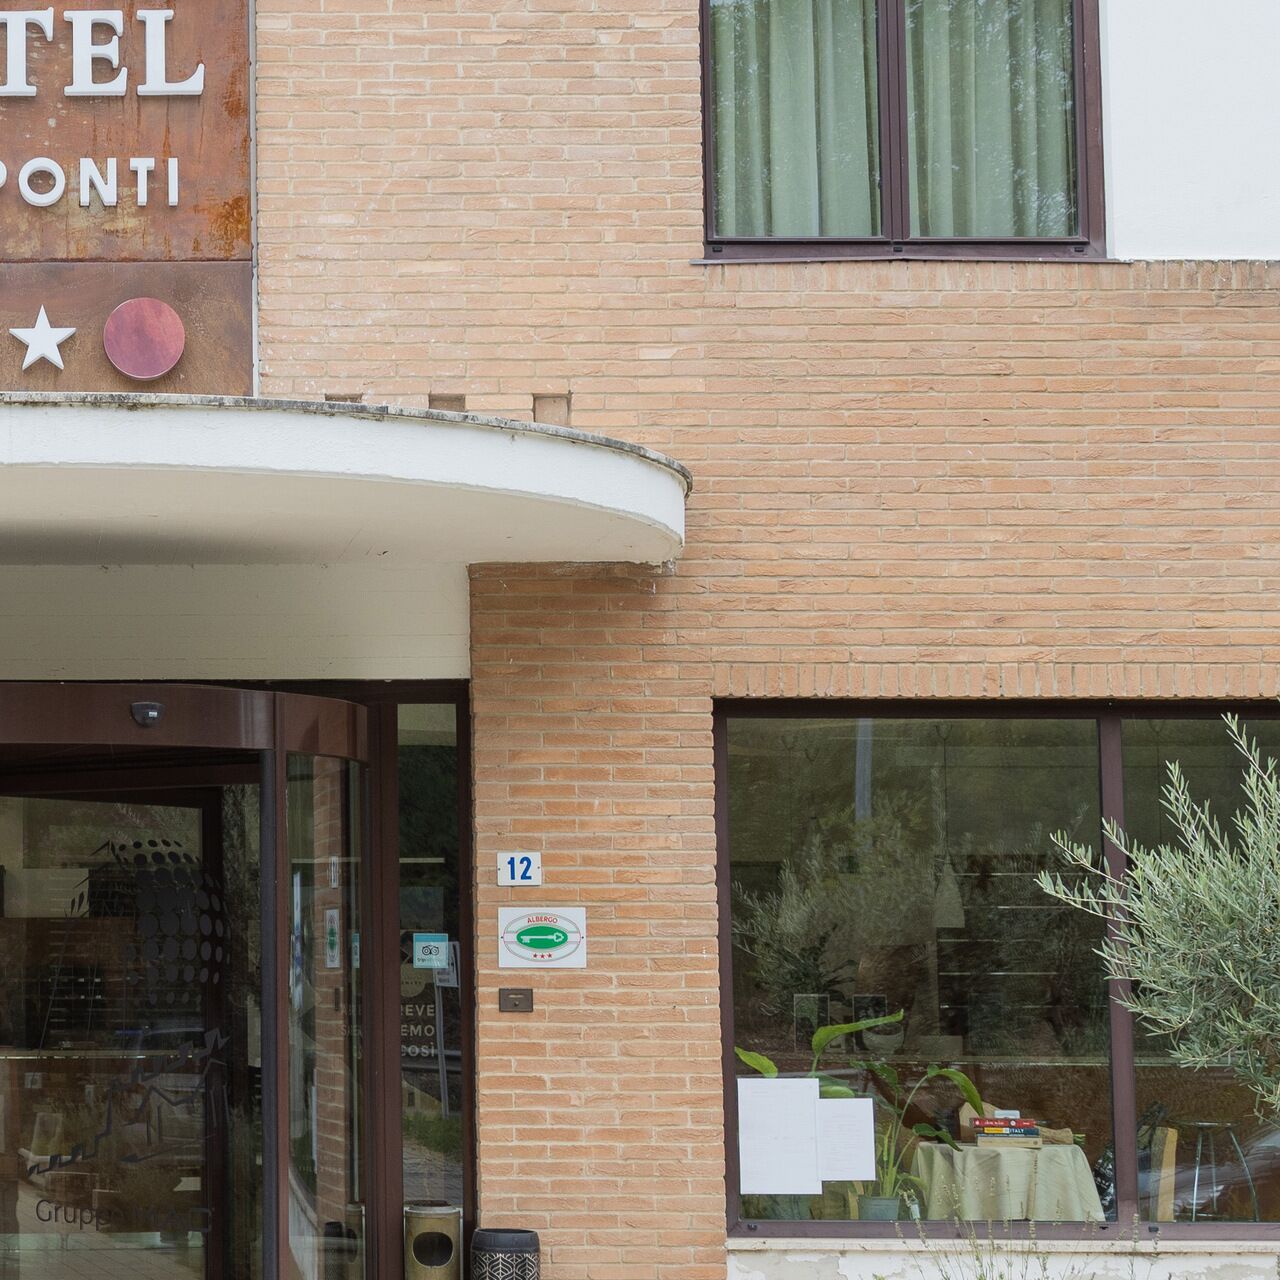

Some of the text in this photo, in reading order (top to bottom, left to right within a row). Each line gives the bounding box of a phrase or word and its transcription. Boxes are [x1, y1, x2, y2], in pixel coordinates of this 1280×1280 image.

[507, 856, 532, 880] 12
[527, 915, 558, 924] ALBERGO
[401, 1004, 435, 1017] EVE
